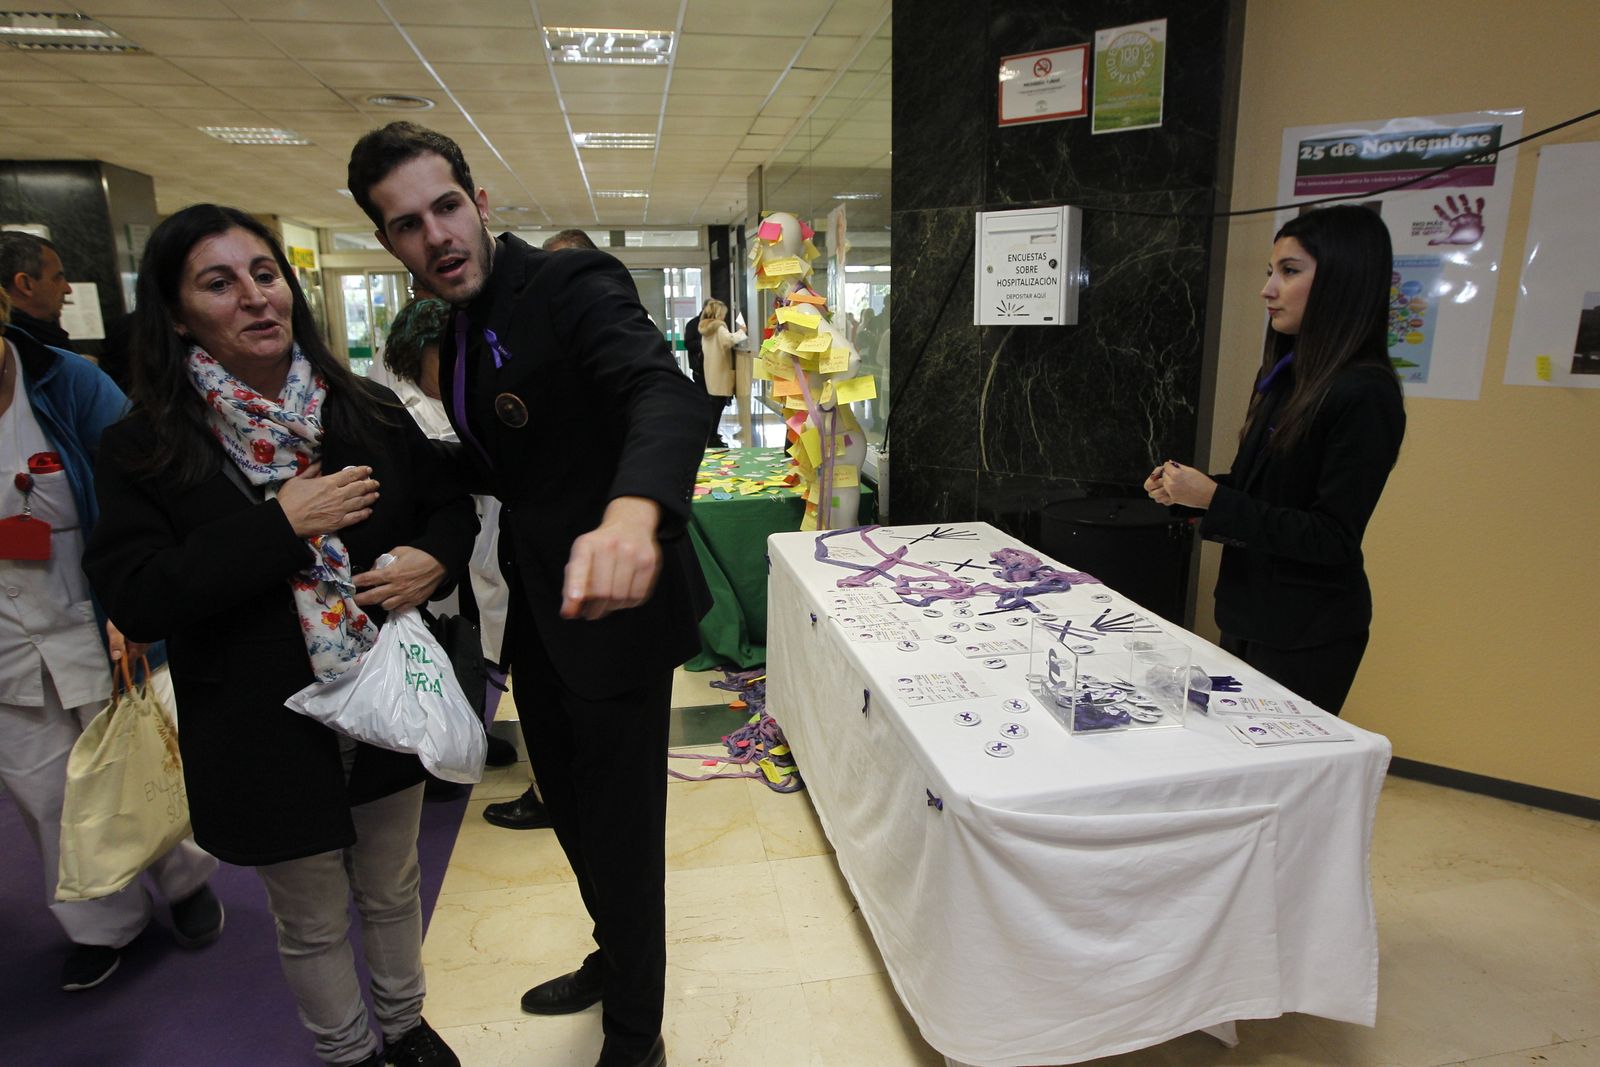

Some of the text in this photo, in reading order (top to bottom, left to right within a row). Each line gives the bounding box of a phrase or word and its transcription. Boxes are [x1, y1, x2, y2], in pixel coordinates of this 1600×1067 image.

[1300, 132, 1492, 160] 25 de Noviembre
[1008, 252, 1047, 262] ENCUESTAS
[1016, 265, 1038, 274] SOBRE
[997, 277, 1058, 287] HOSPITALIZACIÓN
